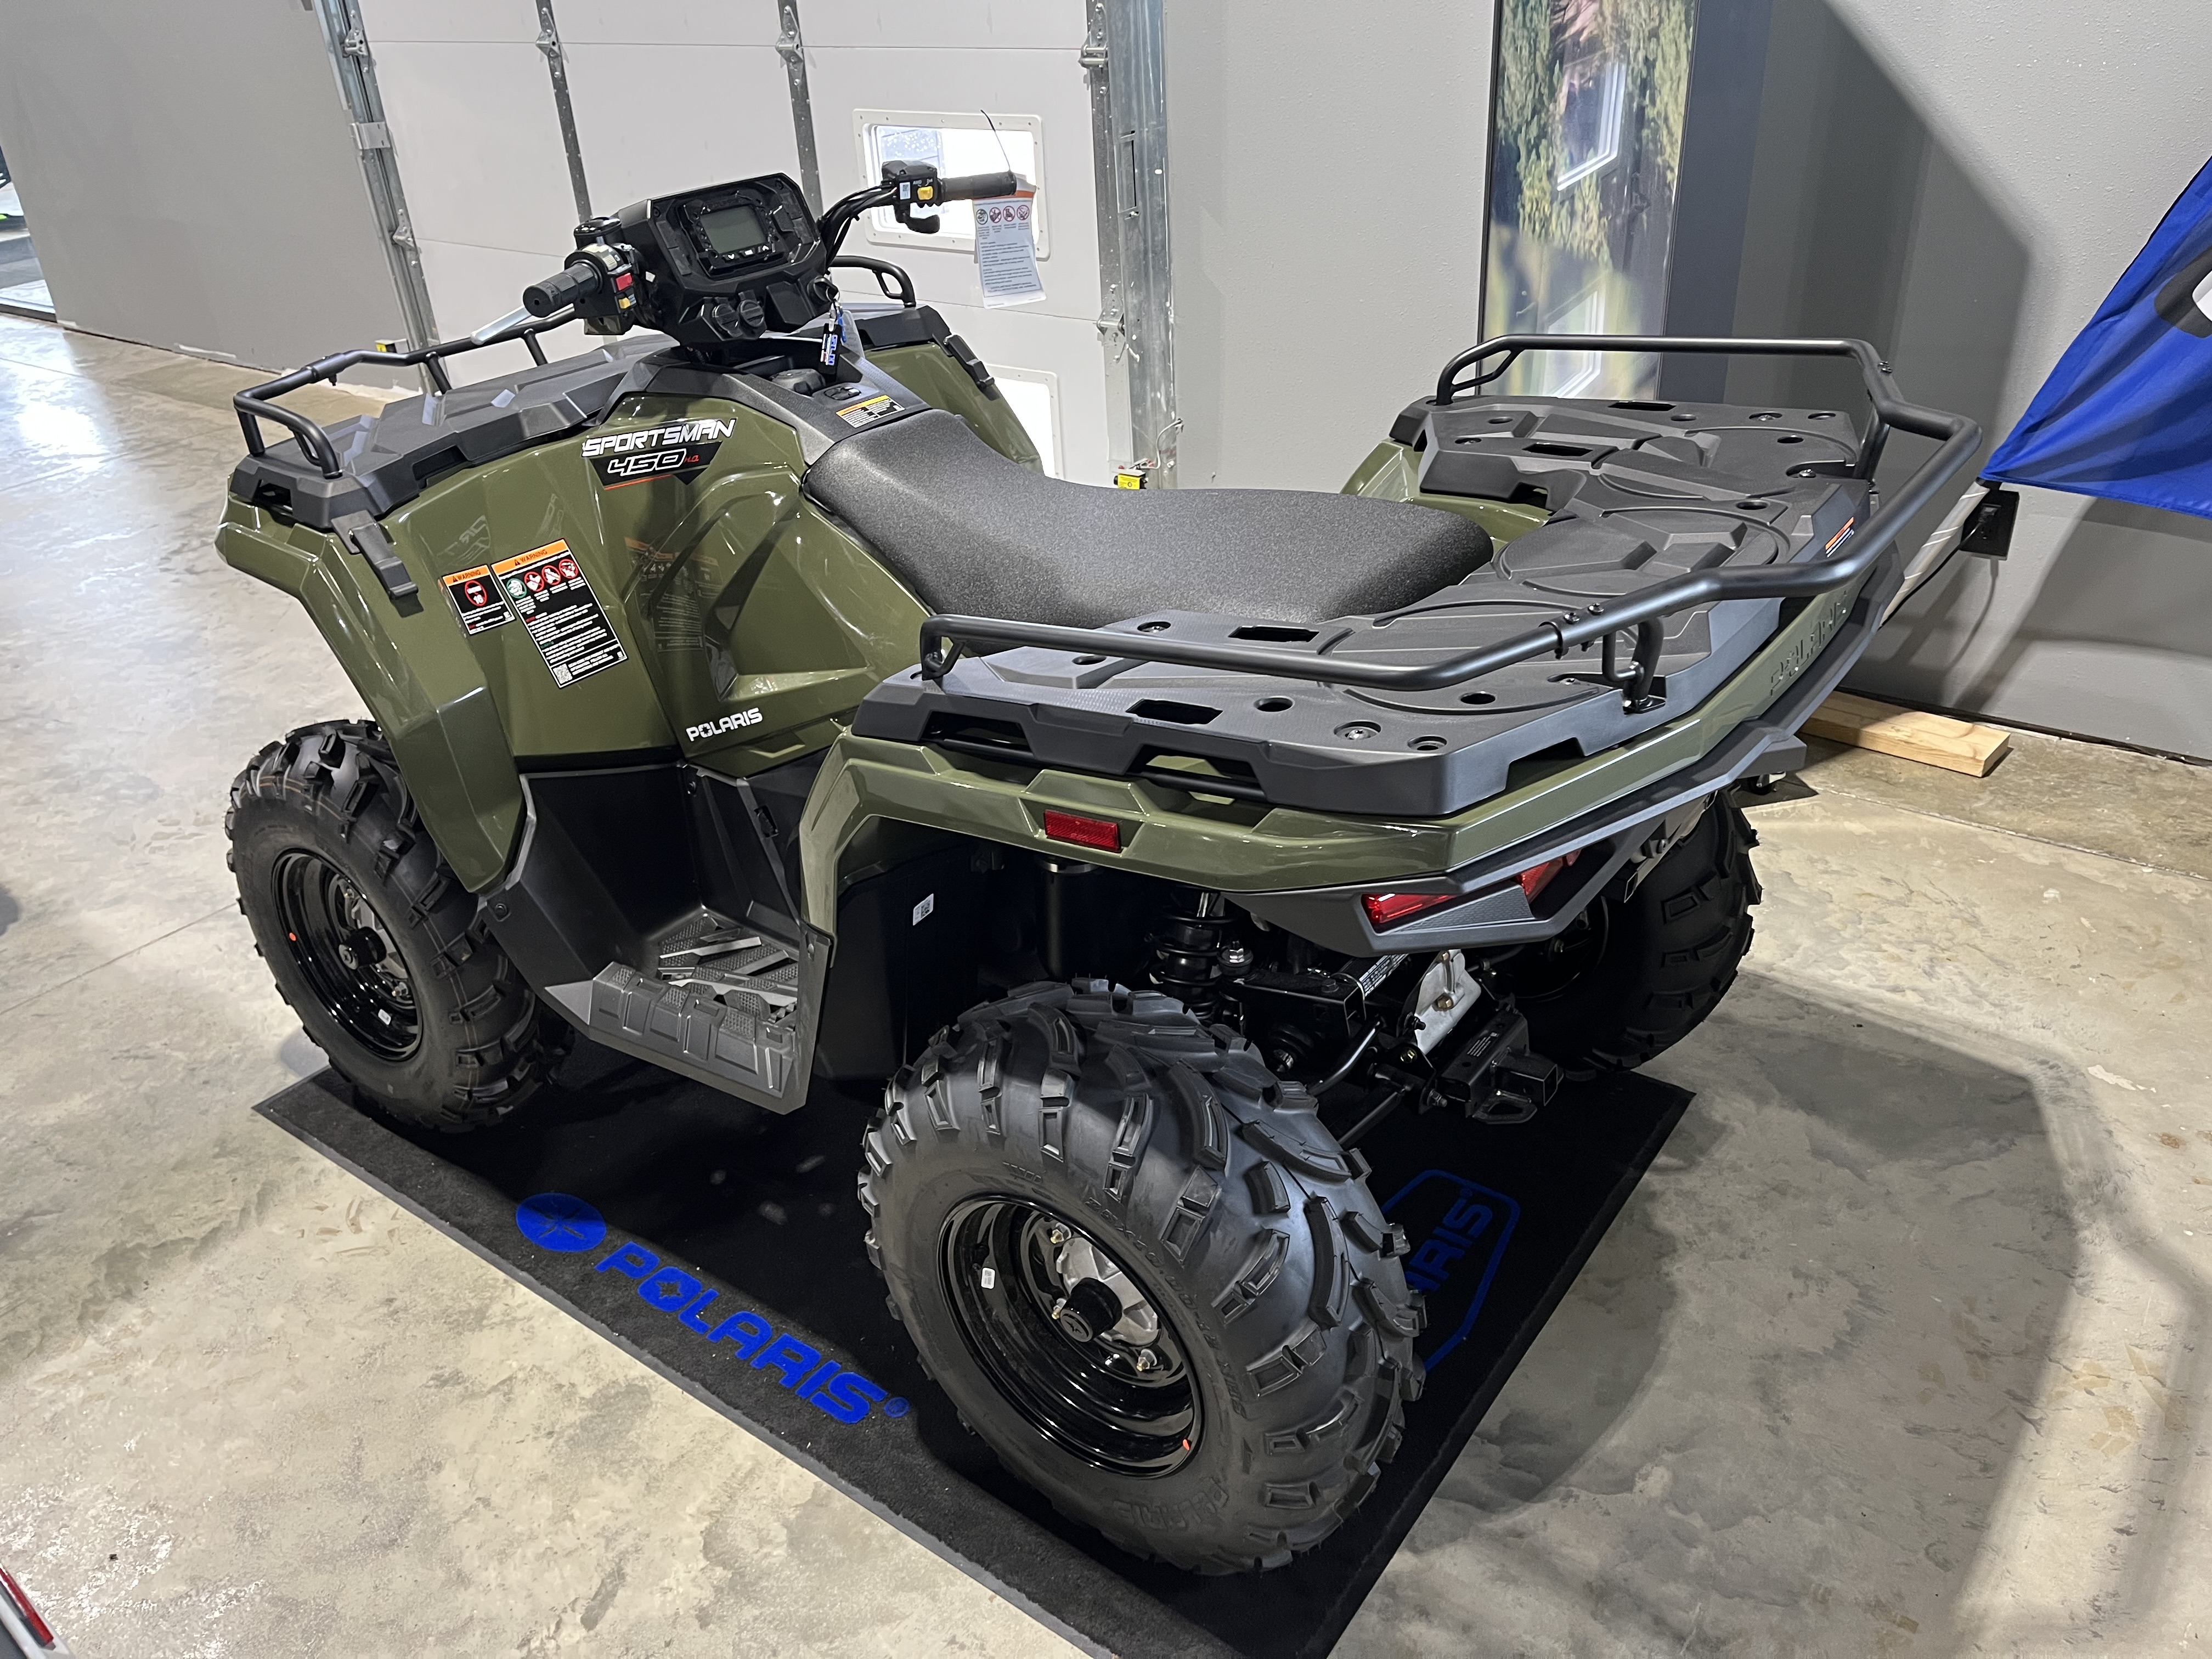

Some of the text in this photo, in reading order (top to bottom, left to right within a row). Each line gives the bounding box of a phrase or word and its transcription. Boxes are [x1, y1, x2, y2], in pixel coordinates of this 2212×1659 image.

[582, 419, 736, 457] SPORTSMAN
[607, 449, 686, 476] 450
[521, 549, 548, 563] WARNING
[456, 569, 481, 580] WARNING
[686, 707, 763, 742] POLARIS
[595, 1241, 888, 1424] POLARIS
